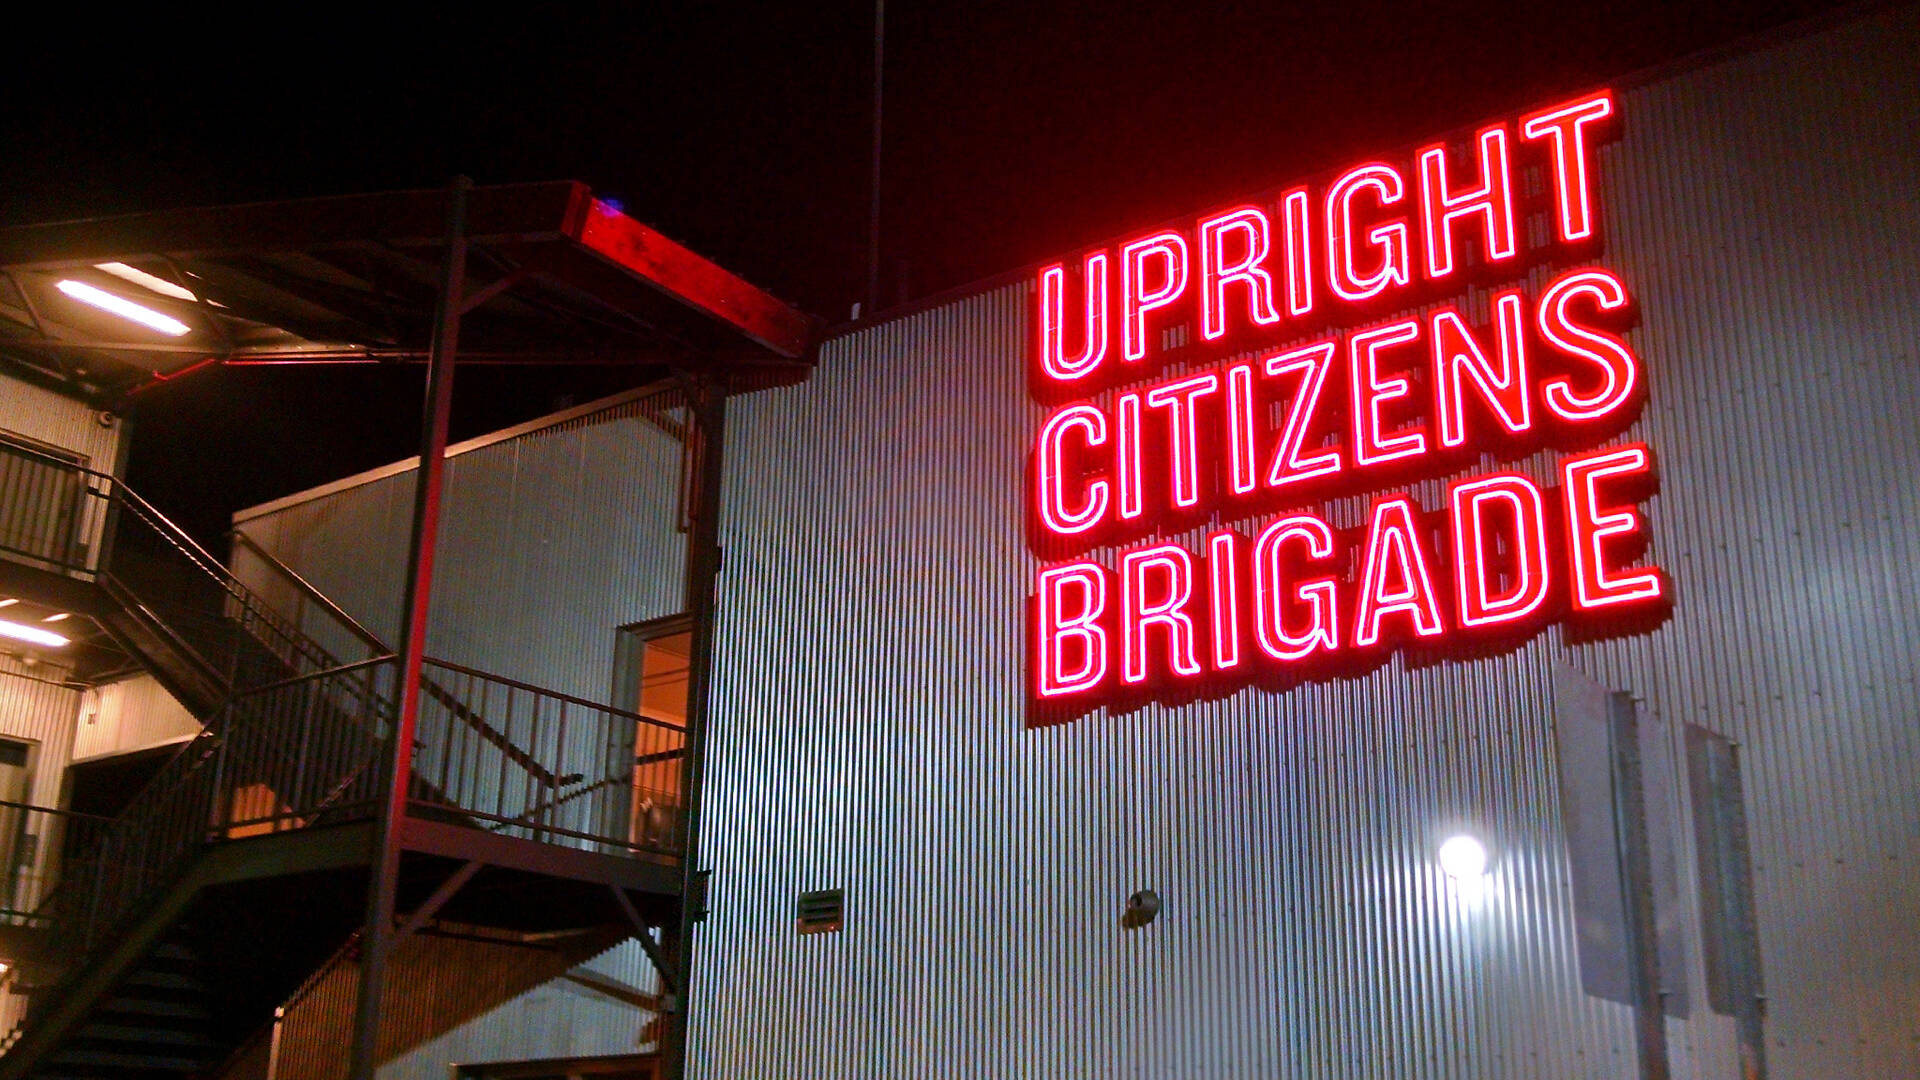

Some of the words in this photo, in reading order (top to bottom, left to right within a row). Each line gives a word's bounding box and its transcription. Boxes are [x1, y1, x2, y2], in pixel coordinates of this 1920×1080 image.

[1037, 89, 1613, 381] UPRIGHT
[1036, 268, 1638, 537] CITIZENS
[1037, 443, 1662, 698] BRIGADE
